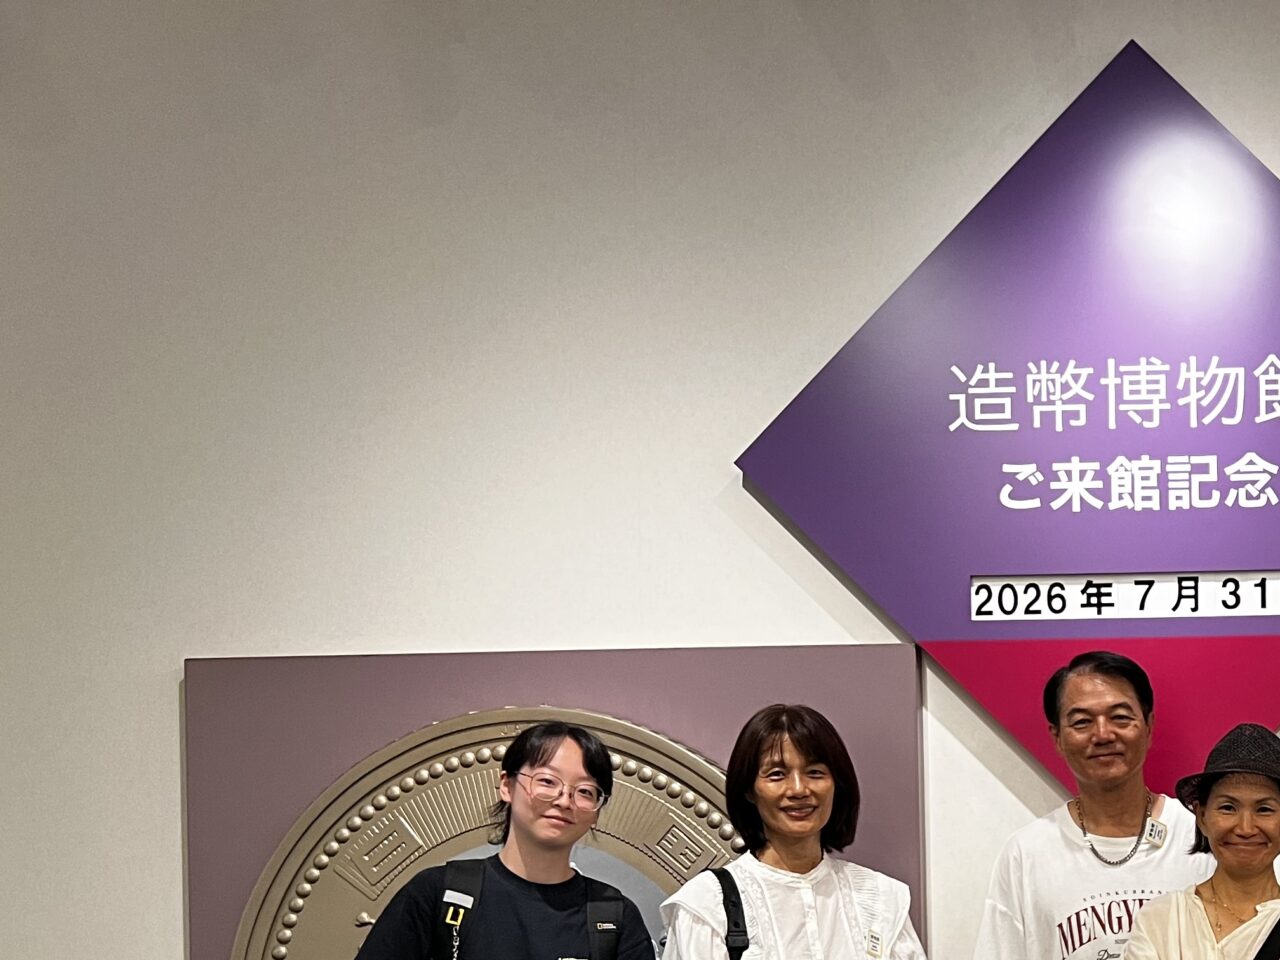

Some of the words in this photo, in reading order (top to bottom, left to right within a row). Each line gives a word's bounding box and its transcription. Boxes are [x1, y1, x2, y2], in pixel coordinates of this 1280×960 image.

[1000, 451, 1280, 513] ご来館記念
